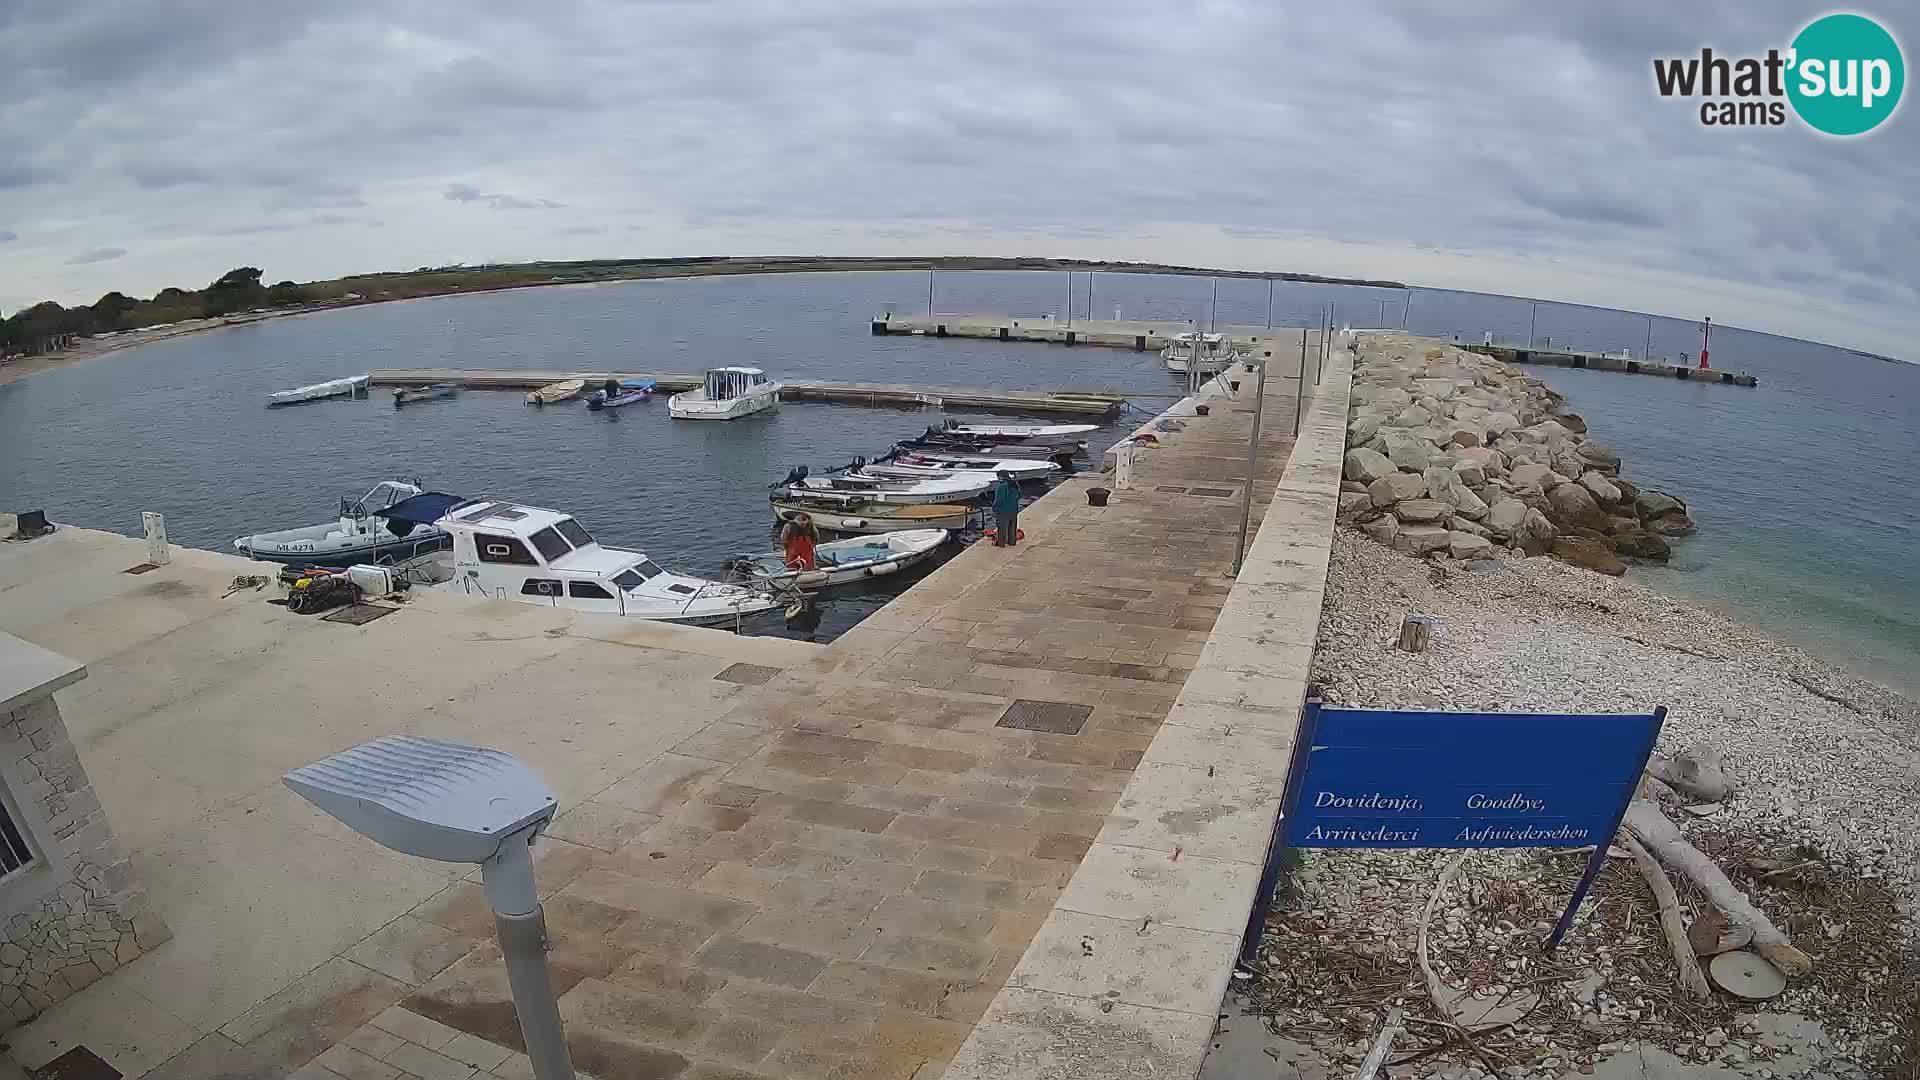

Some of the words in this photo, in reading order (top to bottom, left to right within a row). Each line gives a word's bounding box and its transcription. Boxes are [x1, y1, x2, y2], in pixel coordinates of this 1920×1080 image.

[1466, 793, 1546, 813] Goodbye,
[1305, 825, 1420, 841] Arrivederci
[1455, 824, 1588, 843] Aufwiedersehen
